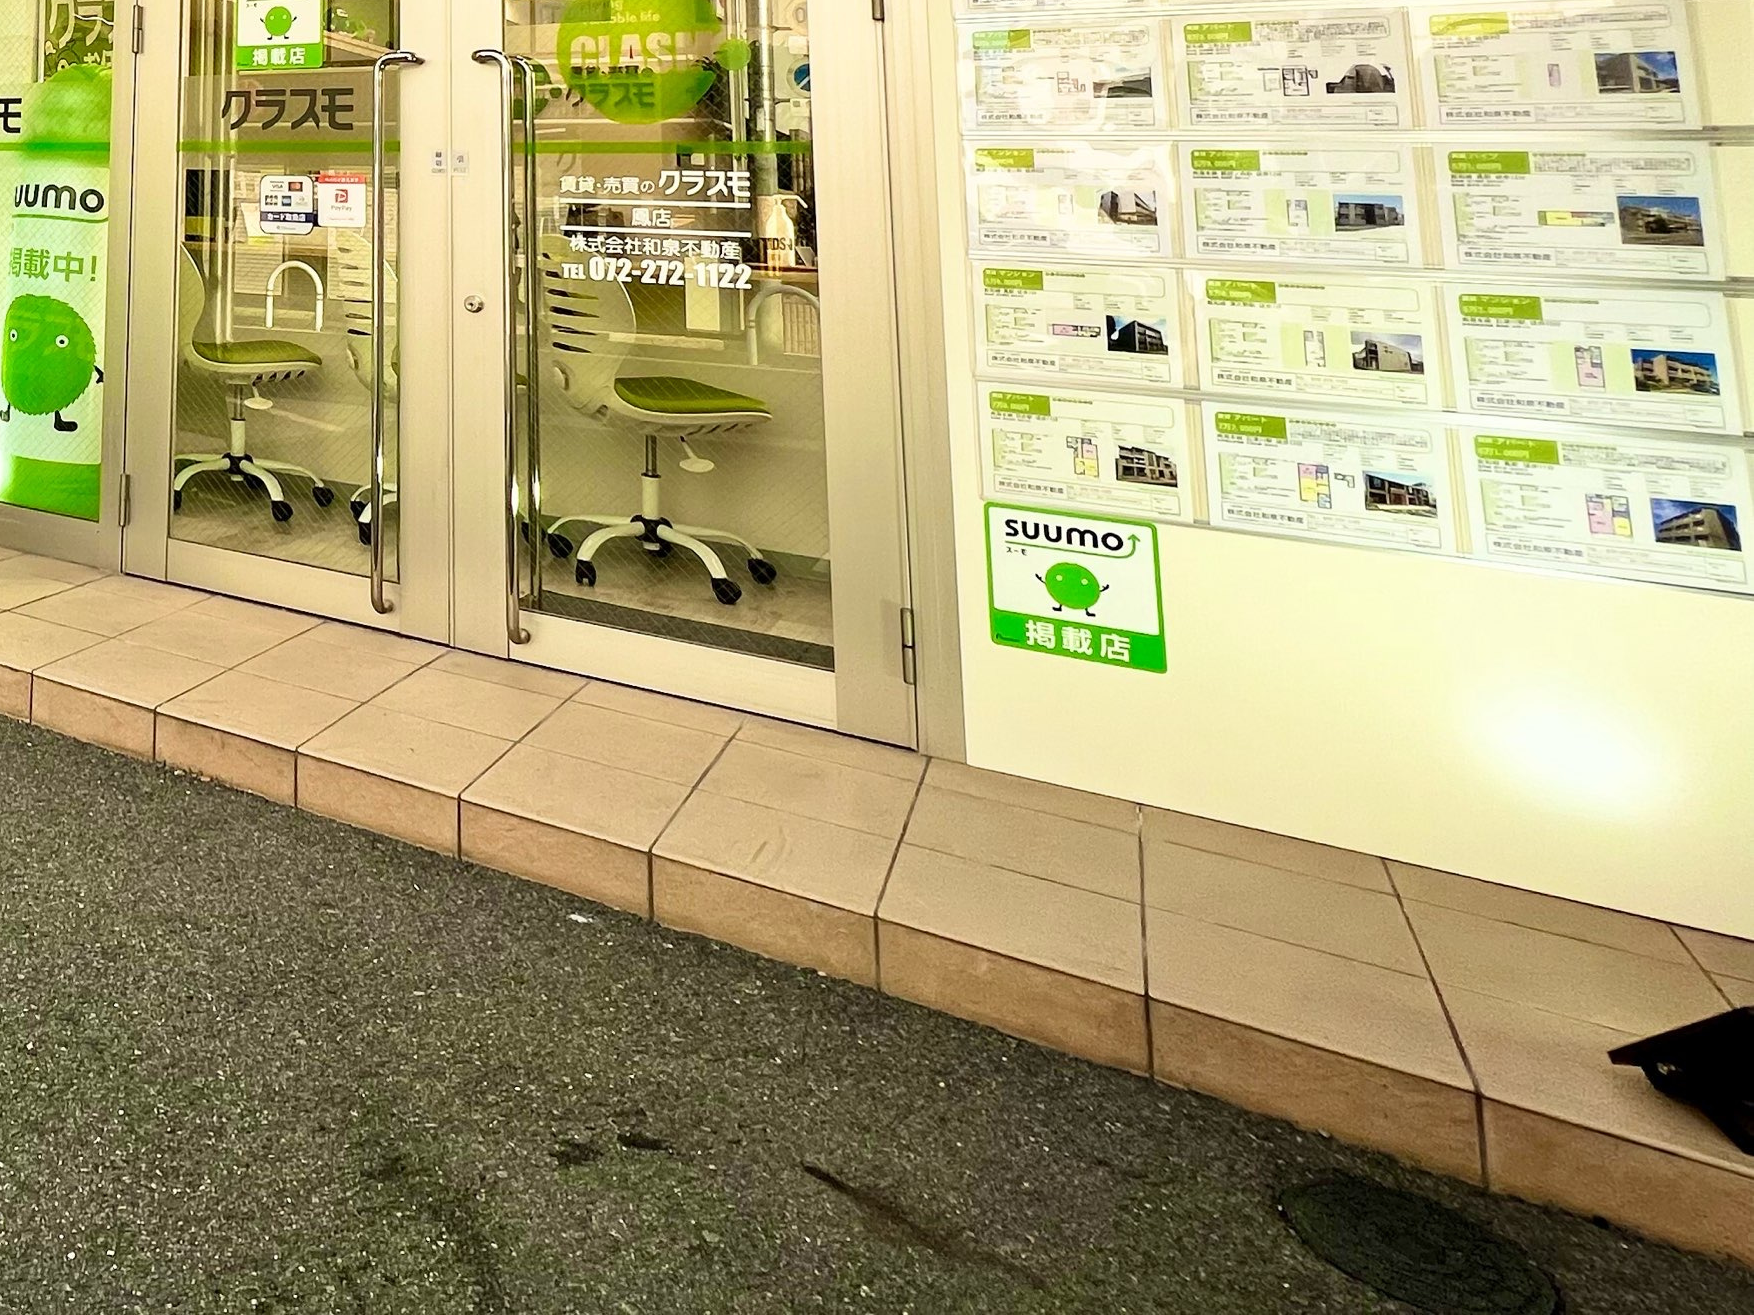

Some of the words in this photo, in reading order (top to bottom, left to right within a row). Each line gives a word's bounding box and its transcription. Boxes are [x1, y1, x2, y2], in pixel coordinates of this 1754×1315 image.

[251, 45, 306, 67] 掲載店
[221, 87, 354, 131] クラスモ
[631, 207, 672, 228] 鳳店
[568, 236, 743, 261] 株式会社和泉不動産
[561, 263, 587, 281] TEL
[588, 257, 753, 290] 072-272-1122
[1024, 619, 1131, 663] 掲載店
